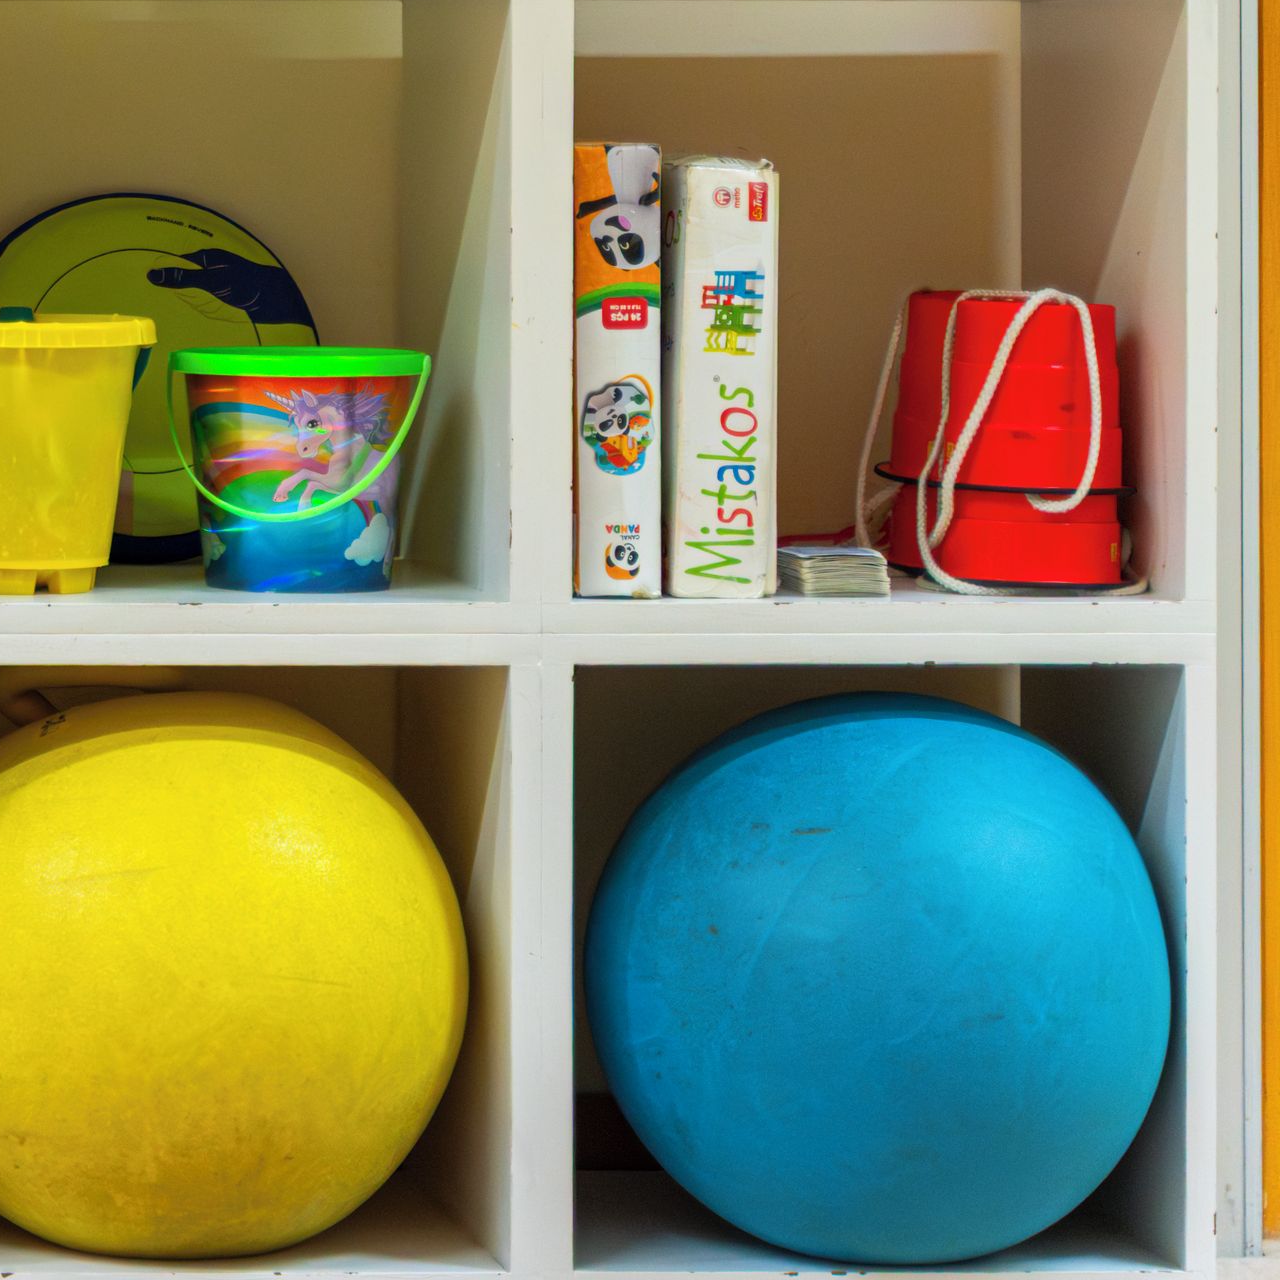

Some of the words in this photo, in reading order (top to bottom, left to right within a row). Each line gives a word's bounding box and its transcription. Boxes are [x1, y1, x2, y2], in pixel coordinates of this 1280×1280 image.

[631, 312, 642, 321] 24
[684, 384, 759, 585] Mistakos
[605, 524, 641, 534] PANDA
